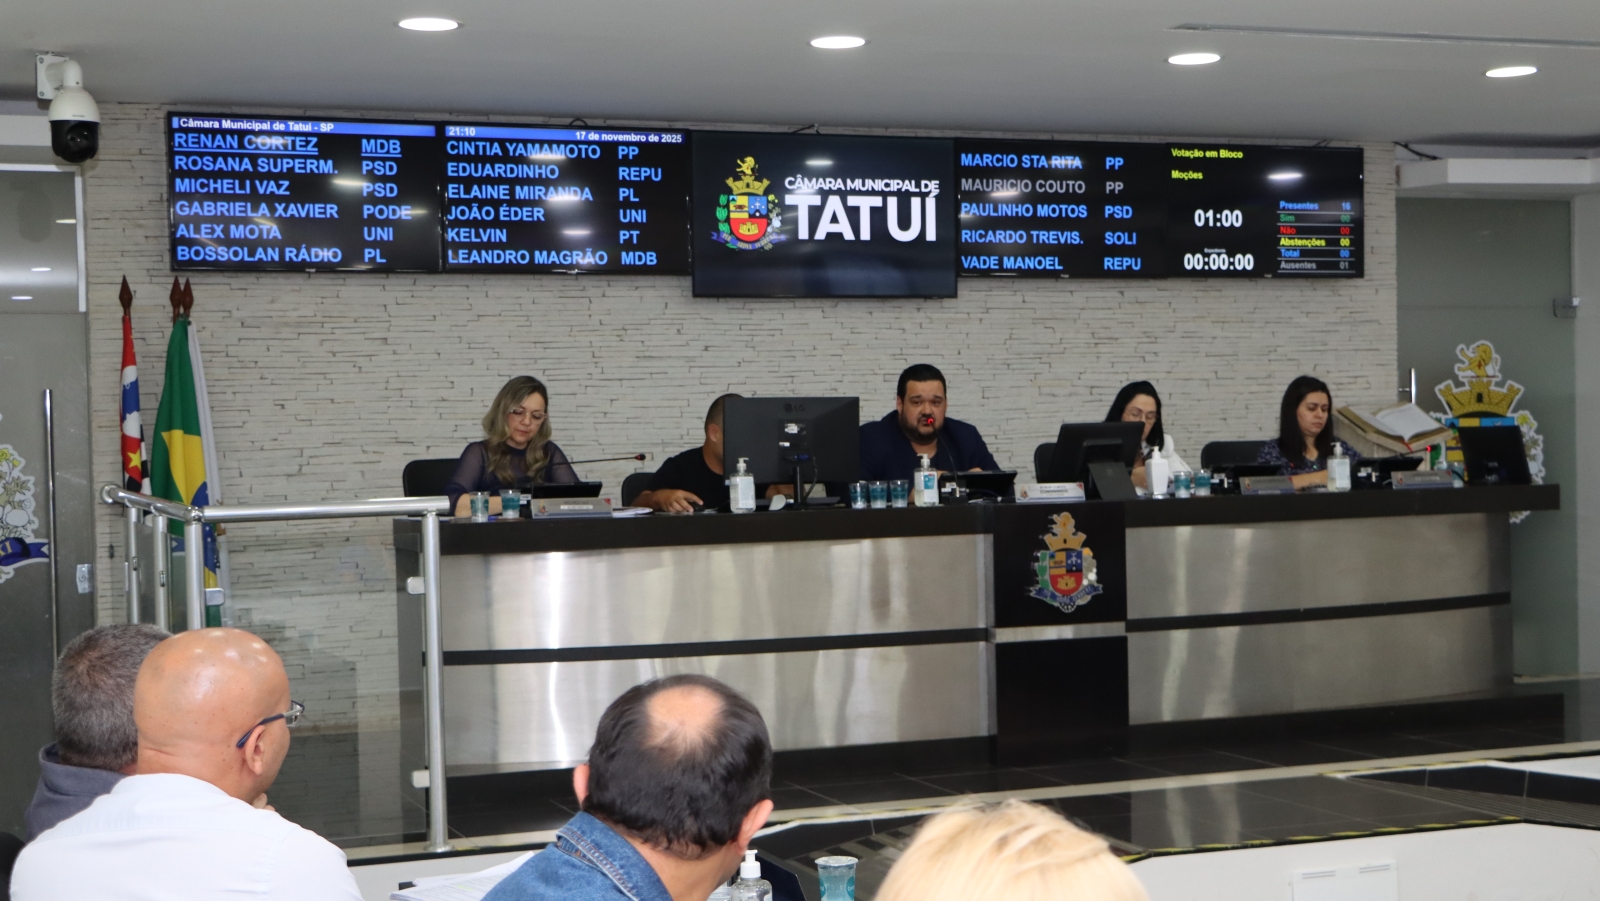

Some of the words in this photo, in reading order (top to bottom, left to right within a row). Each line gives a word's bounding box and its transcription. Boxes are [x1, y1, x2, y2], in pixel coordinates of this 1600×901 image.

[180, 119, 219, 128] Câmara
[222, 120, 270, 130] Municipal
[273, 121, 285, 130] de
[288, 121, 311, 131] Tatuí
[320, 123, 333, 132] SP
[449, 127, 475, 136] 21:10
[174, 133, 238, 149] RENAN
[244, 135, 318, 151] CORTEZ
[362, 139, 401, 153] MDB
[576, 132, 586, 140] 17
[588, 132, 599, 141] de
[602, 133, 646, 141] novembro
[648, 134, 659, 142] de
[661, 134, 682, 142] 2025
[447, 141, 502, 156] CINTIA
[506, 143, 600, 159] YAMAMOTO
[619, 146, 638, 159] PP
[1171, 148, 1203, 158] Votação
[1205, 150, 1218, 158] em
[1220, 149, 1243, 158] Bloco
[174, 156, 252, 172] ROSANA
[257, 158, 338, 174] SUPERM.
[362, 161, 397, 175] PSD
[961, 154, 1018, 167] MARCIO
[1022, 155, 1048, 168] STA
[1052, 156, 1082, 169] RITA
[1106, 157, 1124, 169] PP
[447, 163, 559, 179] EDUARDINHO
[619, 168, 661, 181] REPU
[1172, 170, 1203, 180] Moções
[175, 178, 250, 194] MICHELI
[255, 180, 290, 195] VAZ
[363, 184, 398, 197] PSD
[785, 175, 844, 191] CÂMARA
[847, 178, 920, 192] MUNICIPAL
[921, 180, 939, 192] DE
[961, 178, 1031, 193] MAURICIO
[1036, 180, 1085, 193] COUTO
[1106, 182, 1123, 194] PP
[447, 184, 510, 199] ELAINE
[516, 186, 593, 201] MIRANDA
[619, 189, 639, 201] PL
[176, 201, 270, 217] GABRIELA
[274, 203, 338, 218] XAVIER
[363, 205, 412, 220] PODE
[447, 203, 494, 220] JOÃO
[500, 204, 545, 221] ÉDER
[620, 210, 647, 223] UNI
[961, 203, 1033, 216] PAULINHO
[1037, 205, 1087, 218] MOTOS
[1105, 206, 1132, 218] PSD
[1280, 202, 1318, 210] Presentes
[785, 192, 939, 242] TATUÍ
[1195, 210, 1243, 227] 01:00
[1280, 214, 1295, 222] Sim
[176, 224, 224, 238] ALEX
[230, 225, 281, 239] MOTA
[363, 227, 393, 241] UNI
[447, 228, 507, 242] KELVIN
[620, 231, 640, 244] PT
[961, 230, 1026, 243] RICARDO
[1030, 231, 1083, 244] TREVIS.
[1105, 232, 1136, 245] SOLI
[1280, 226, 1296, 234] Não
[1280, 238, 1326, 247] Abstenções
[177, 246, 279, 262] BOSSOLAN
[285, 244, 342, 262] RÁDIO
[364, 249, 386, 263] PL
[448, 250, 530, 264] LEANDRO
[535, 248, 608, 265] MAGRÃO
[621, 252, 657, 265] MDB
[961, 256, 999, 269] VADE
[1003, 257, 1063, 269] MANOEL
[1104, 258, 1141, 270] REPU
[1184, 254, 1254, 270] 00:00:00
[1280, 261, 1316, 269] Ausentes
